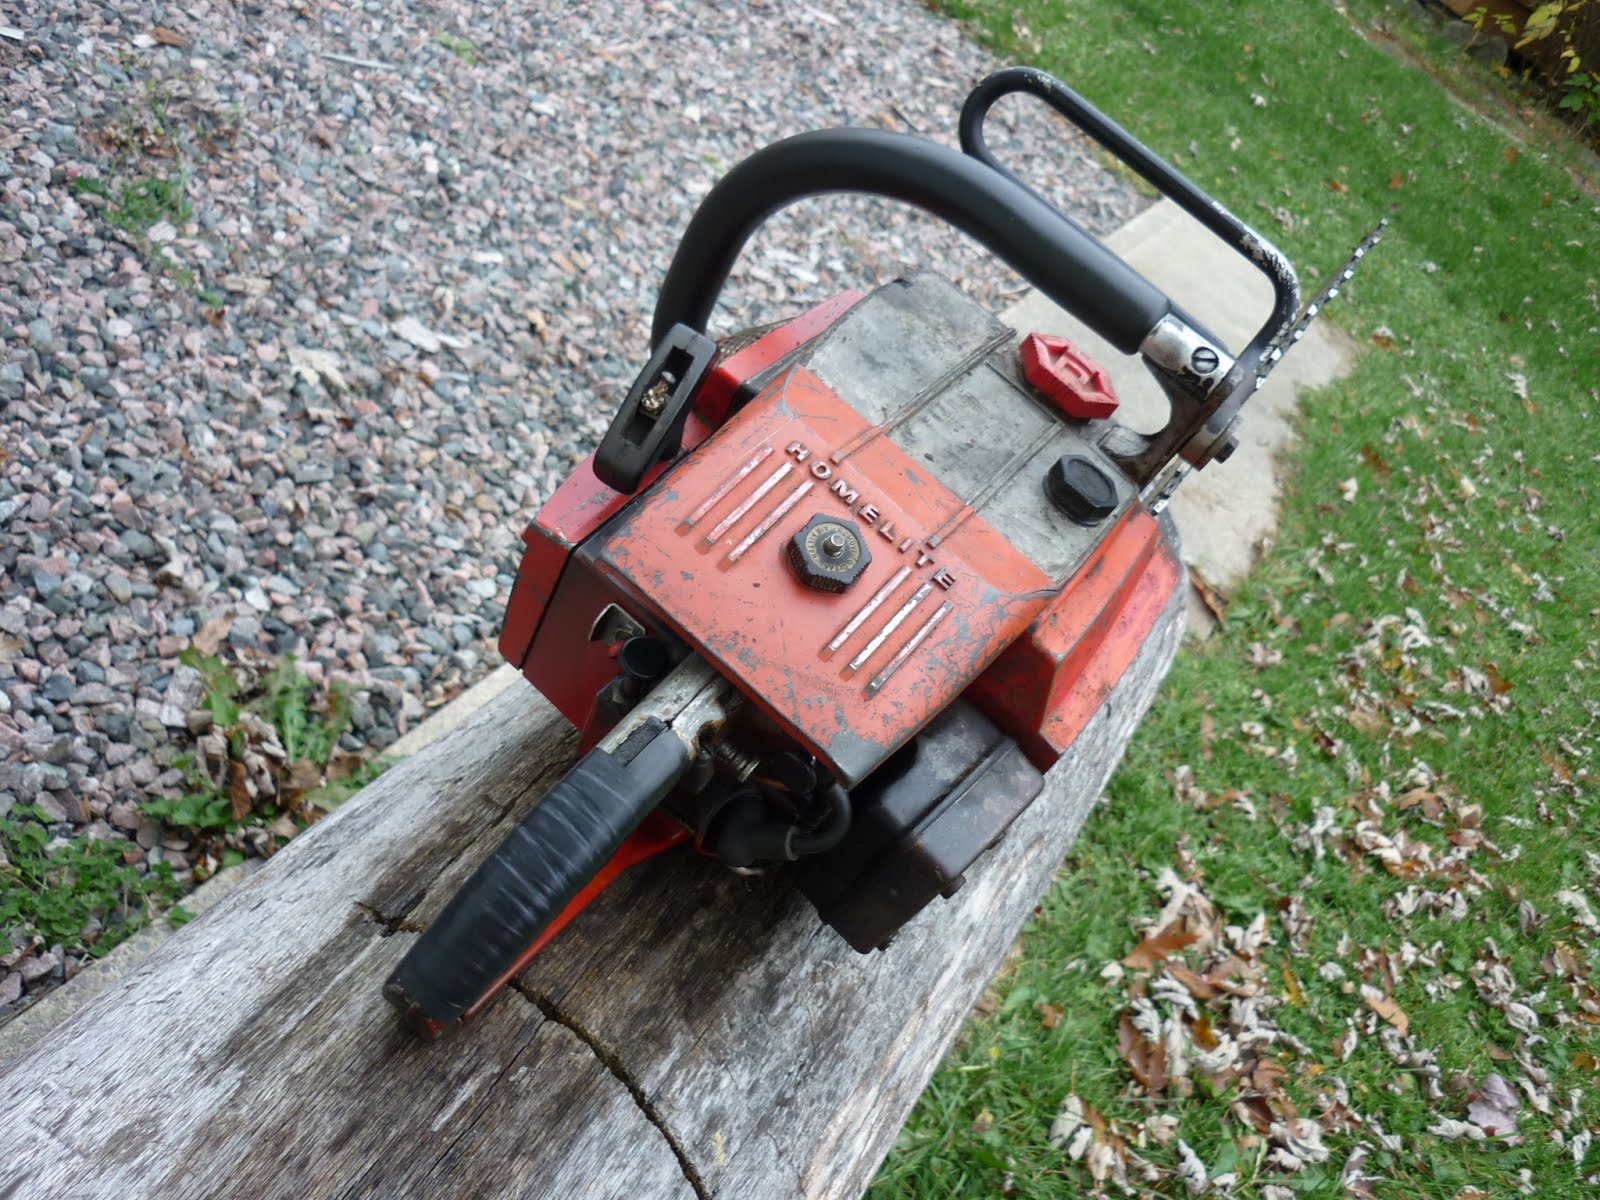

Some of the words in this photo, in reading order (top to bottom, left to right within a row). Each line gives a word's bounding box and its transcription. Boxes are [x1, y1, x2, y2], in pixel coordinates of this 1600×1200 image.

[785, 440, 956, 591] HOMELITE
[815, 525, 829, 534] AIR
[808, 533, 818, 559] FILTER
